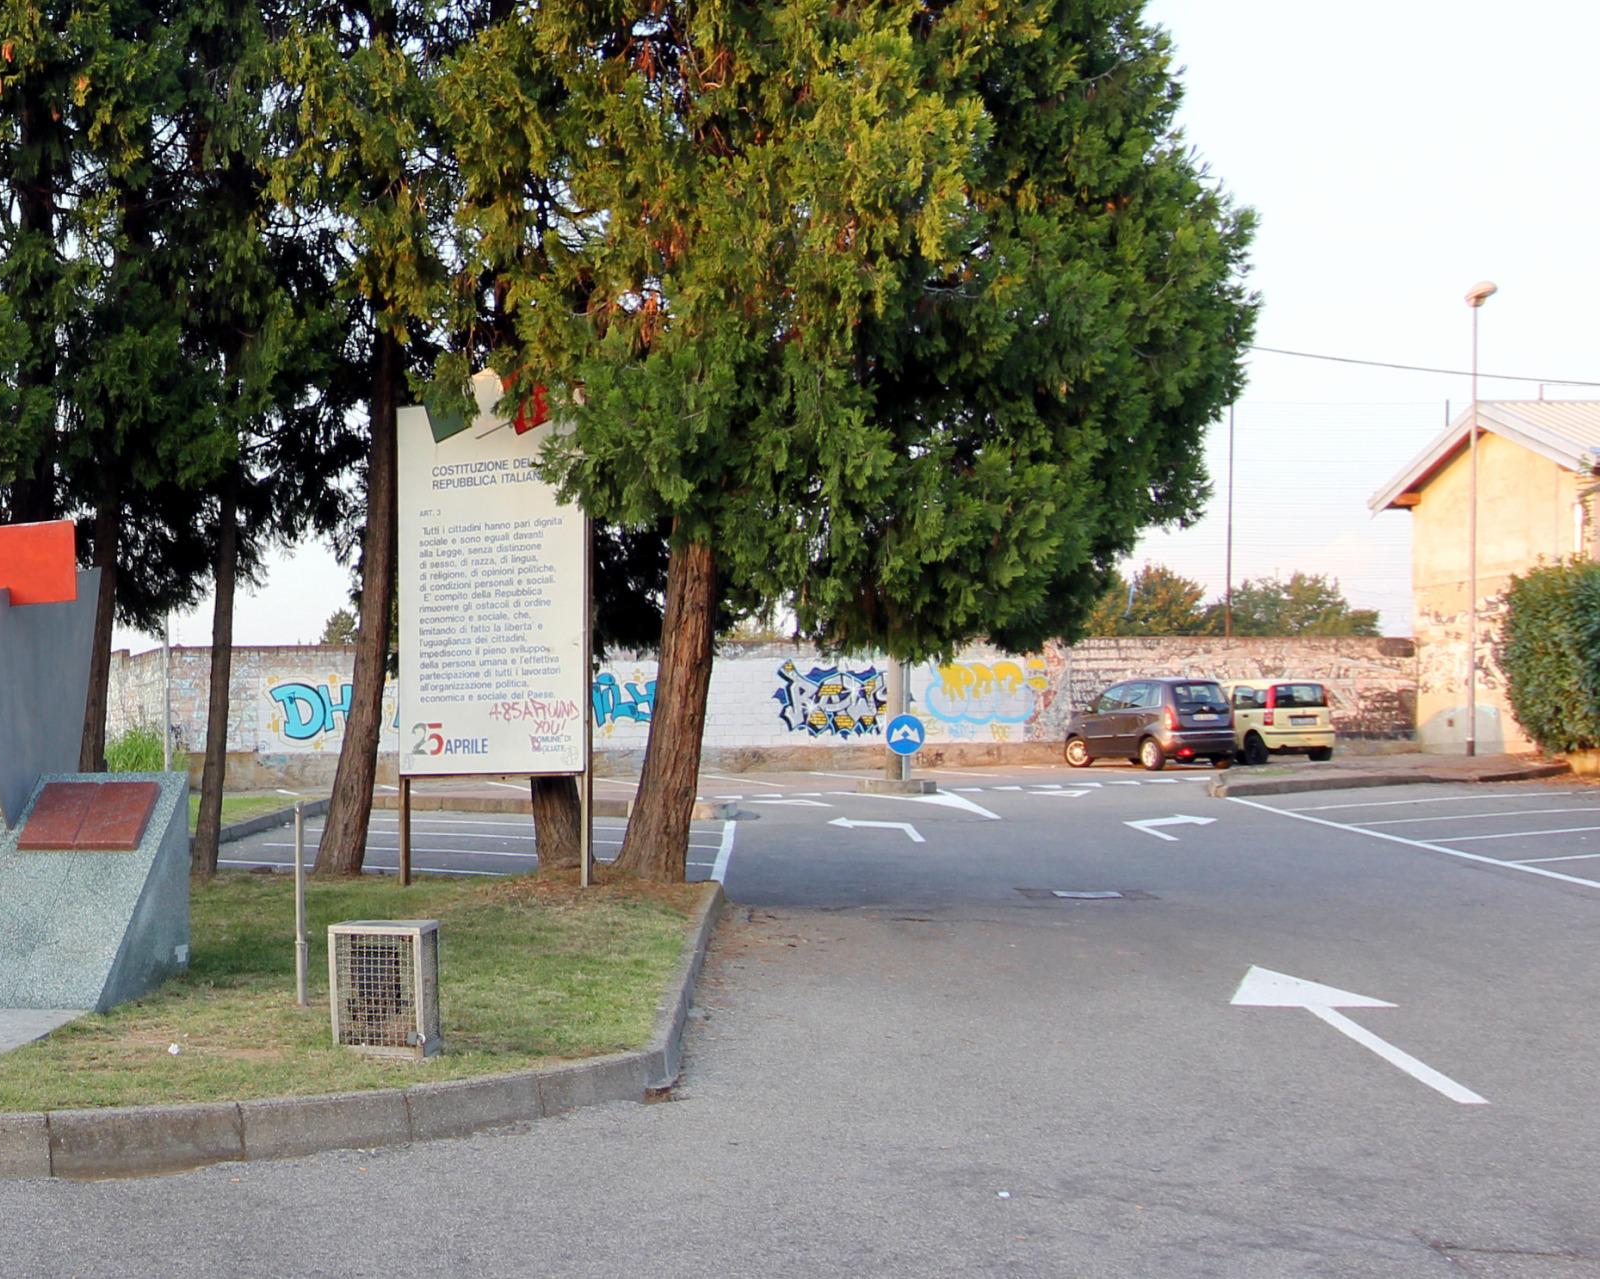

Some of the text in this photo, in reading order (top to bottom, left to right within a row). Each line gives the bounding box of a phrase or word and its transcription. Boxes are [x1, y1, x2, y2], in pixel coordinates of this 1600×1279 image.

[432, 459, 509, 477] COSTITUZIONE
[432, 470, 545, 490] REPUBBLICA ITALIAN
[422, 527, 439, 535] Tutti
[448, 524, 481, 533] cittadini
[485, 522, 511, 530] hanno
[514, 520, 531, 529] pari
[419, 537, 448, 547] sociale
[460, 536, 481, 544] sono
[484, 533, 509, 543] eguali
[513, 531, 543, 540] davanti
[419, 542, 542, 558] alla Legge, senza distinzione
[419, 554, 538, 570] di sesso, di razza, di lingua,
[419, 563, 556, 581] di religione, di opinioni politiche,
[419, 583, 426, 592] di
[430, 581, 471, 592] condizioni
[474, 578, 513, 589] personali
[526, 575, 556, 585] sociali.
[434, 592, 468, 603] compito
[471, 590, 491, 600] della
[495, 587, 542, 599] Repubblica
[419, 598, 551, 614] rimuovere gli ostacoli di ordine
[419, 615, 465, 625] economico
[477, 611, 510, 622] sociale,
[513, 611, 531, 620] che,
[419, 626, 456, 636] limitando
[459, 624, 468, 634] di
[470, 623, 490, 633] fatto
[493, 623, 501, 632] la
[419, 633, 527, 648] l'uguaglianza dei cittadini,
[419, 644, 546, 658] impediscono il pieno sviluppo
[419, 659, 439, 669] della
[441, 658, 476, 669] persona
[479, 658, 508, 667] umana
[520, 655, 560, 665] l'effettiva
[419, 670, 480, 681] partecipazione
[483, 668, 492, 678] di
[495, 668, 512, 677] tutti
[521, 666, 560, 676] lavoratori
[419, 679, 529, 692] all'organizzazione politica,
[420, 694, 465, 703] economica
[477, 691, 507, 701] sociale
[510, 691, 524, 700] del
[528, 690, 556, 699] Paese.
[412, 722, 489, 756] 25 APRILE
